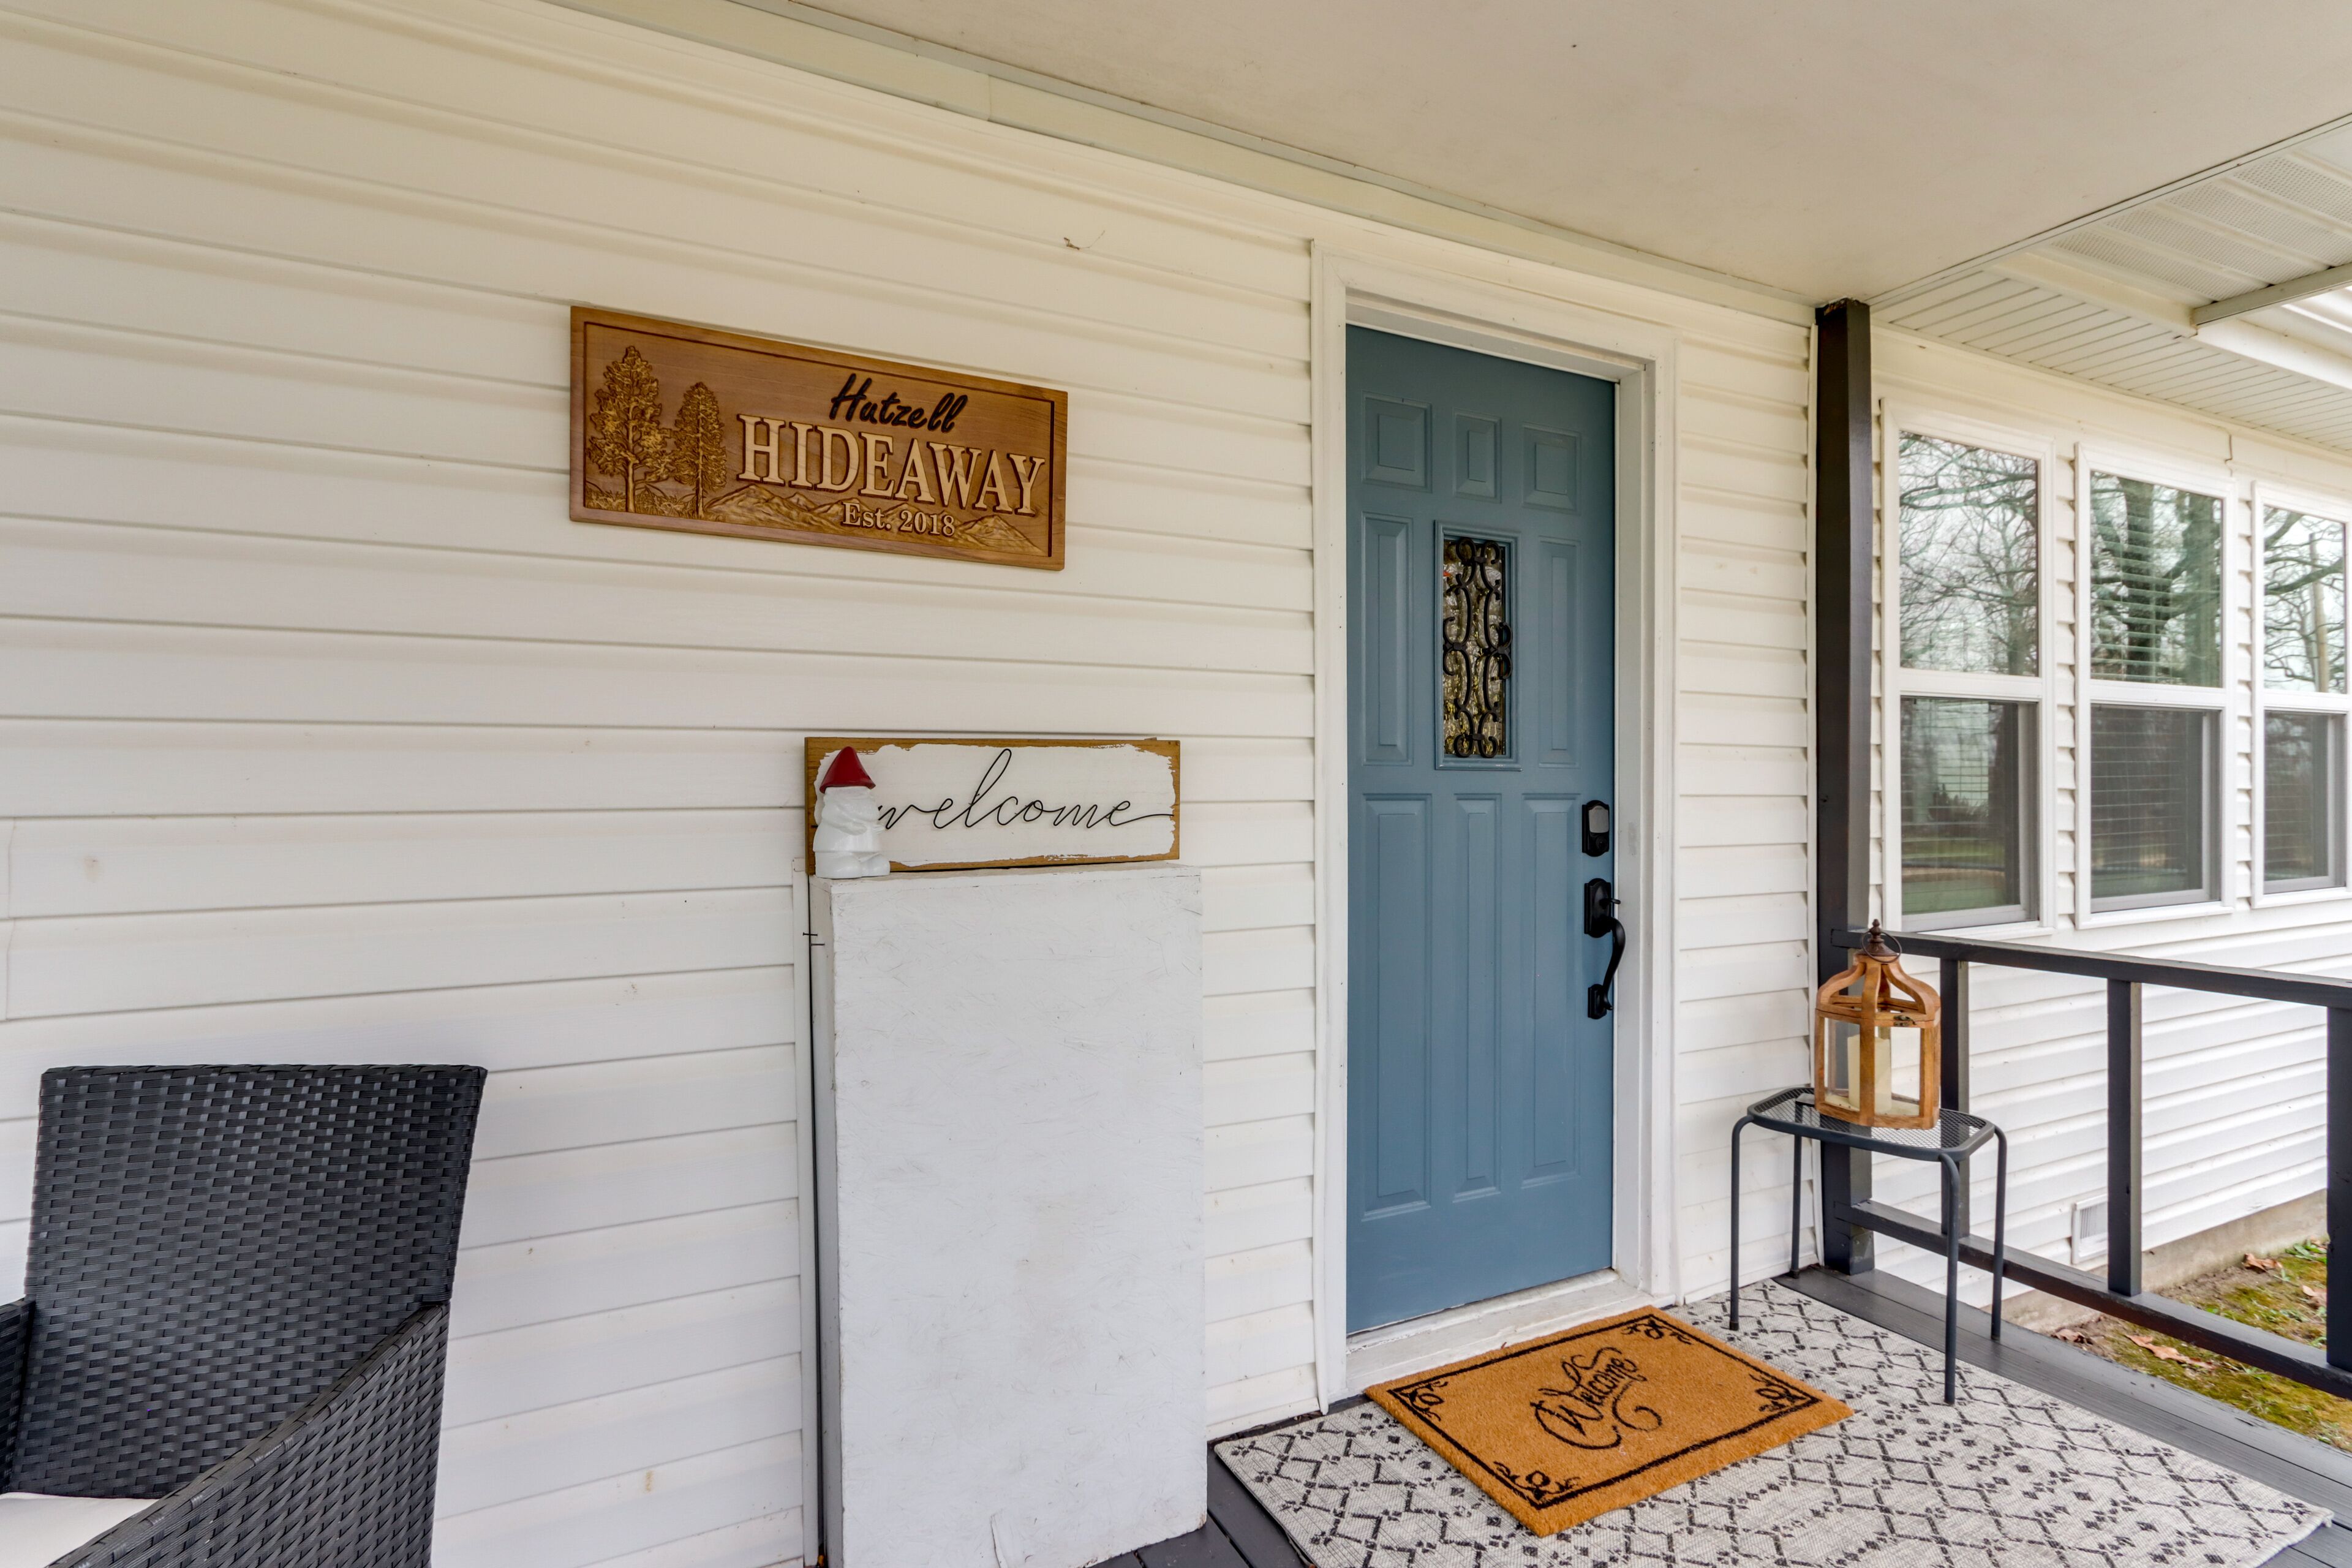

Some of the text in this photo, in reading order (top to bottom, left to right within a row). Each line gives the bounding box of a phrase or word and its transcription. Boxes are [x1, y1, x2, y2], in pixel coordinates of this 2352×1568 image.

[829, 373, 968, 433] Hutzell
[737, 413, 1045, 516] HIDEAWAY
[842, 502, 956, 537] Est. 2018
[1530, 1348, 1662, 1450] Welcome
